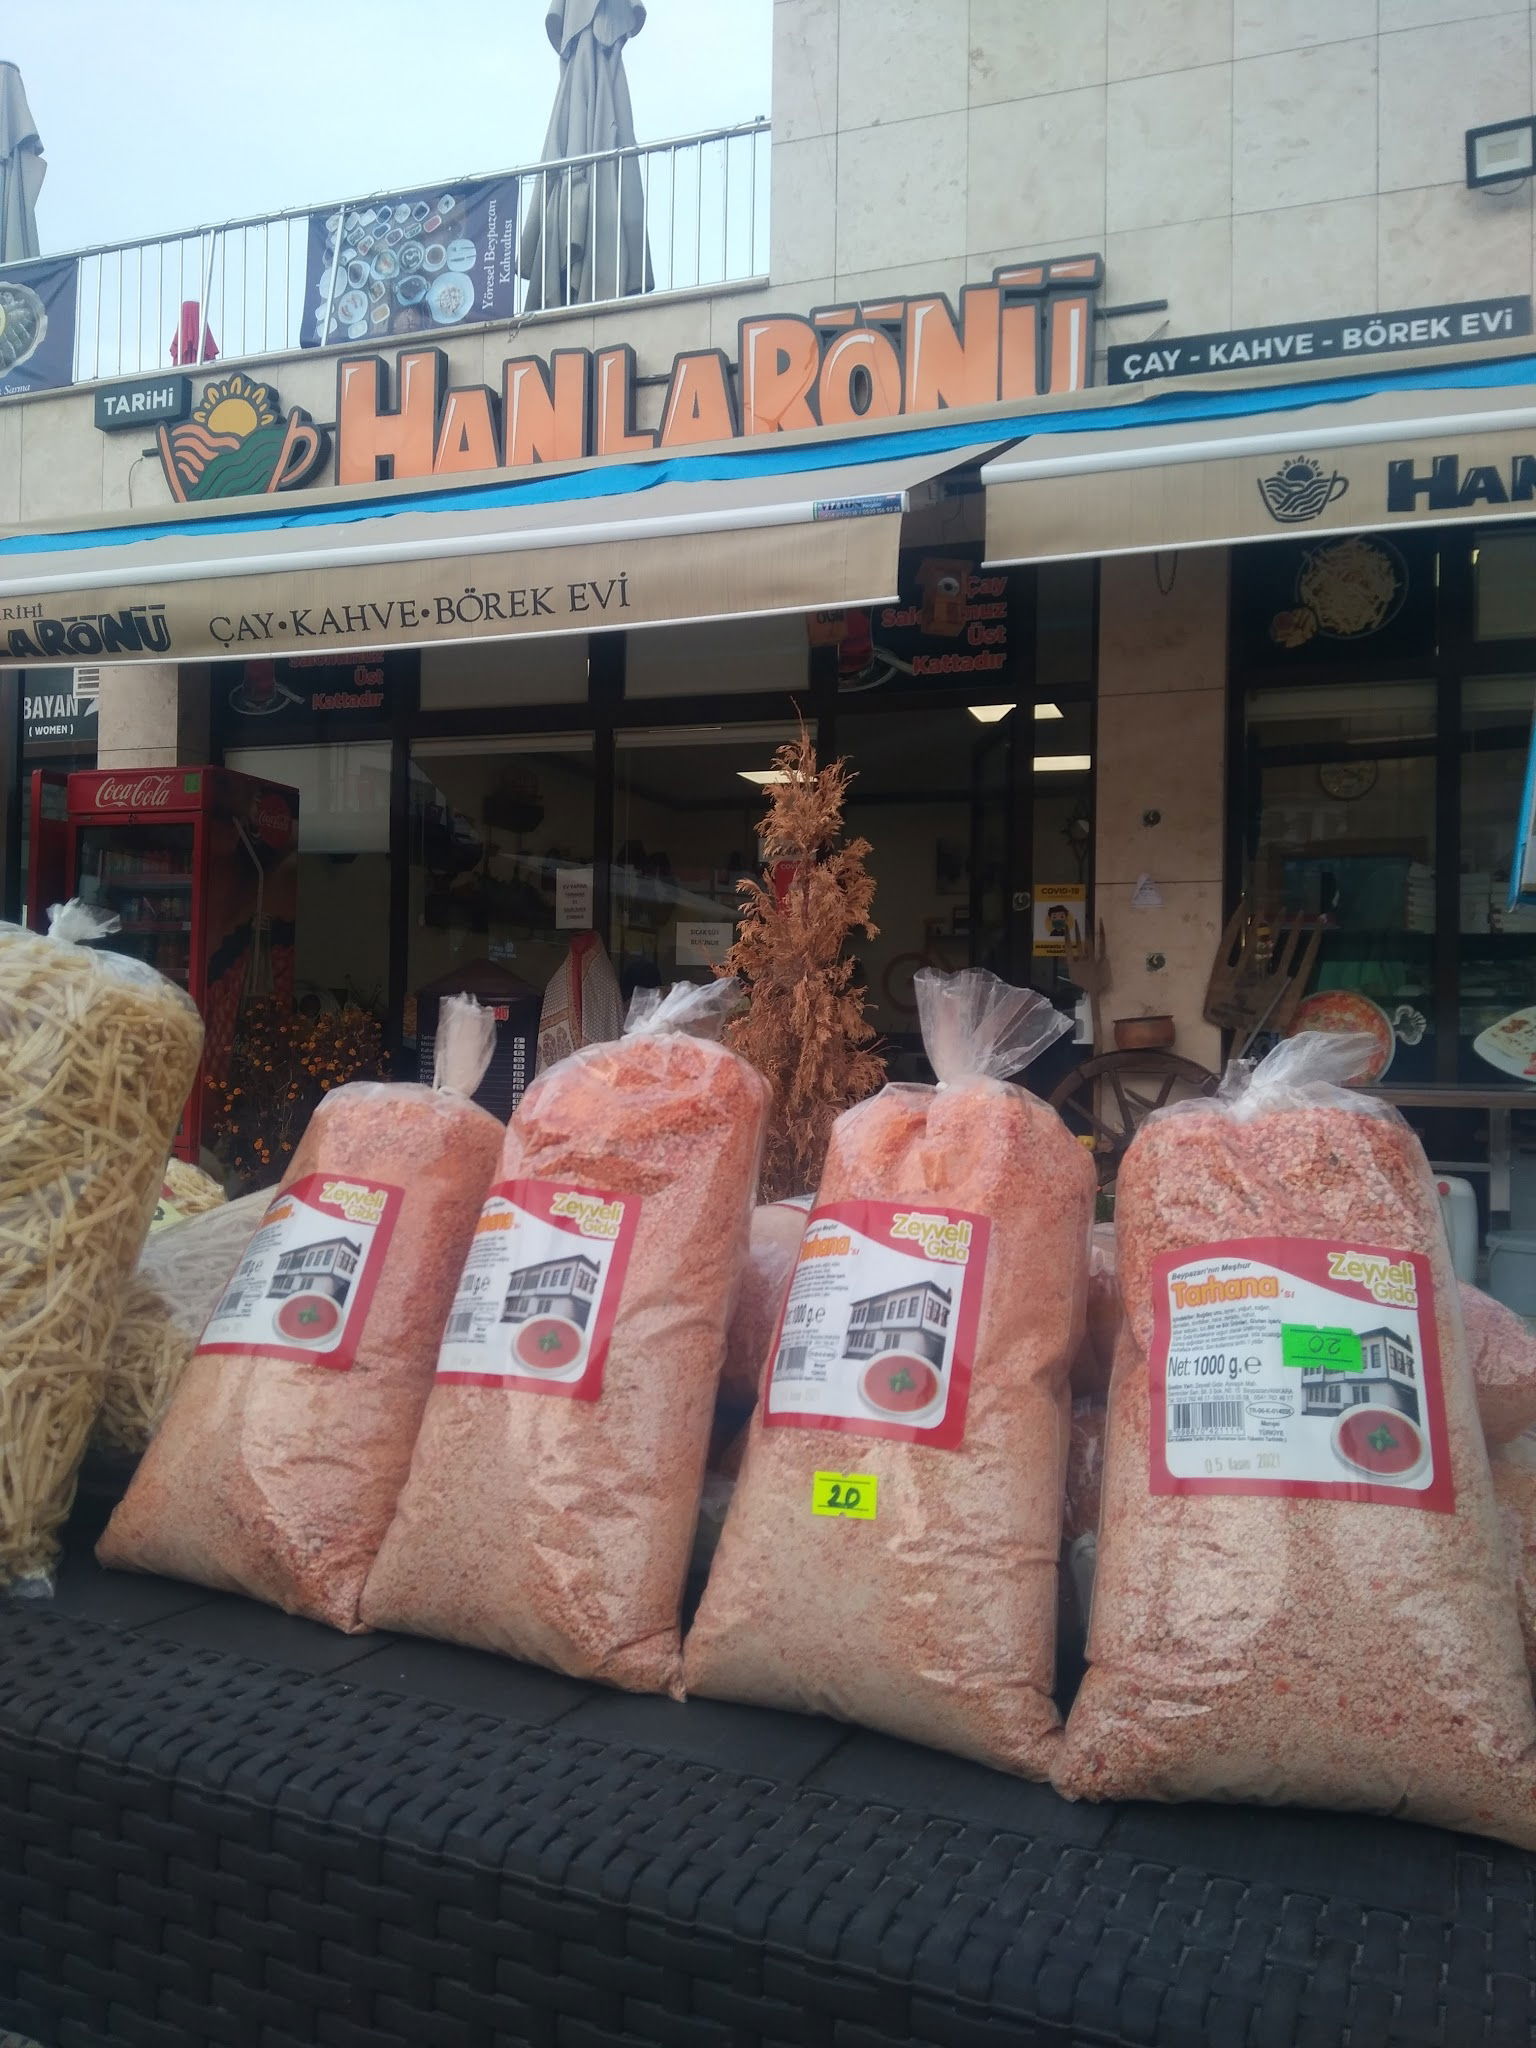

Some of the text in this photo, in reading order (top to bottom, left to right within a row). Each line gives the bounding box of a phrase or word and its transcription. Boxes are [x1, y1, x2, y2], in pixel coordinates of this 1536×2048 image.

[482, 265, 495, 310] Yöresel
[1124, 349, 1181, 380] ÇAY
[1209, 333, 1314, 366] KAHVE
[1343, 316, 1451, 350] BÖREK
[967, 622, 1008, 645] Üst
[24, 694, 79, 720] BAYAN
[322, 1183, 386, 1209] Zeyveli
[553, 1195, 624, 1222] Zeyveli
[893, 1214, 971, 1244] Zeyveli
[1221, 1262, 1252, 1273] Meşhur
[1329, 1253, 1414, 1285] Zeyveli
[1170, 1275, 1279, 1309] Tarhana
[1308, 1335, 1342, 1354] 20
[1168, 1355, 1191, 1378] Net:
[1194, 1353, 1225, 1376] 1000
[827, 1484, 861, 1509] 20
